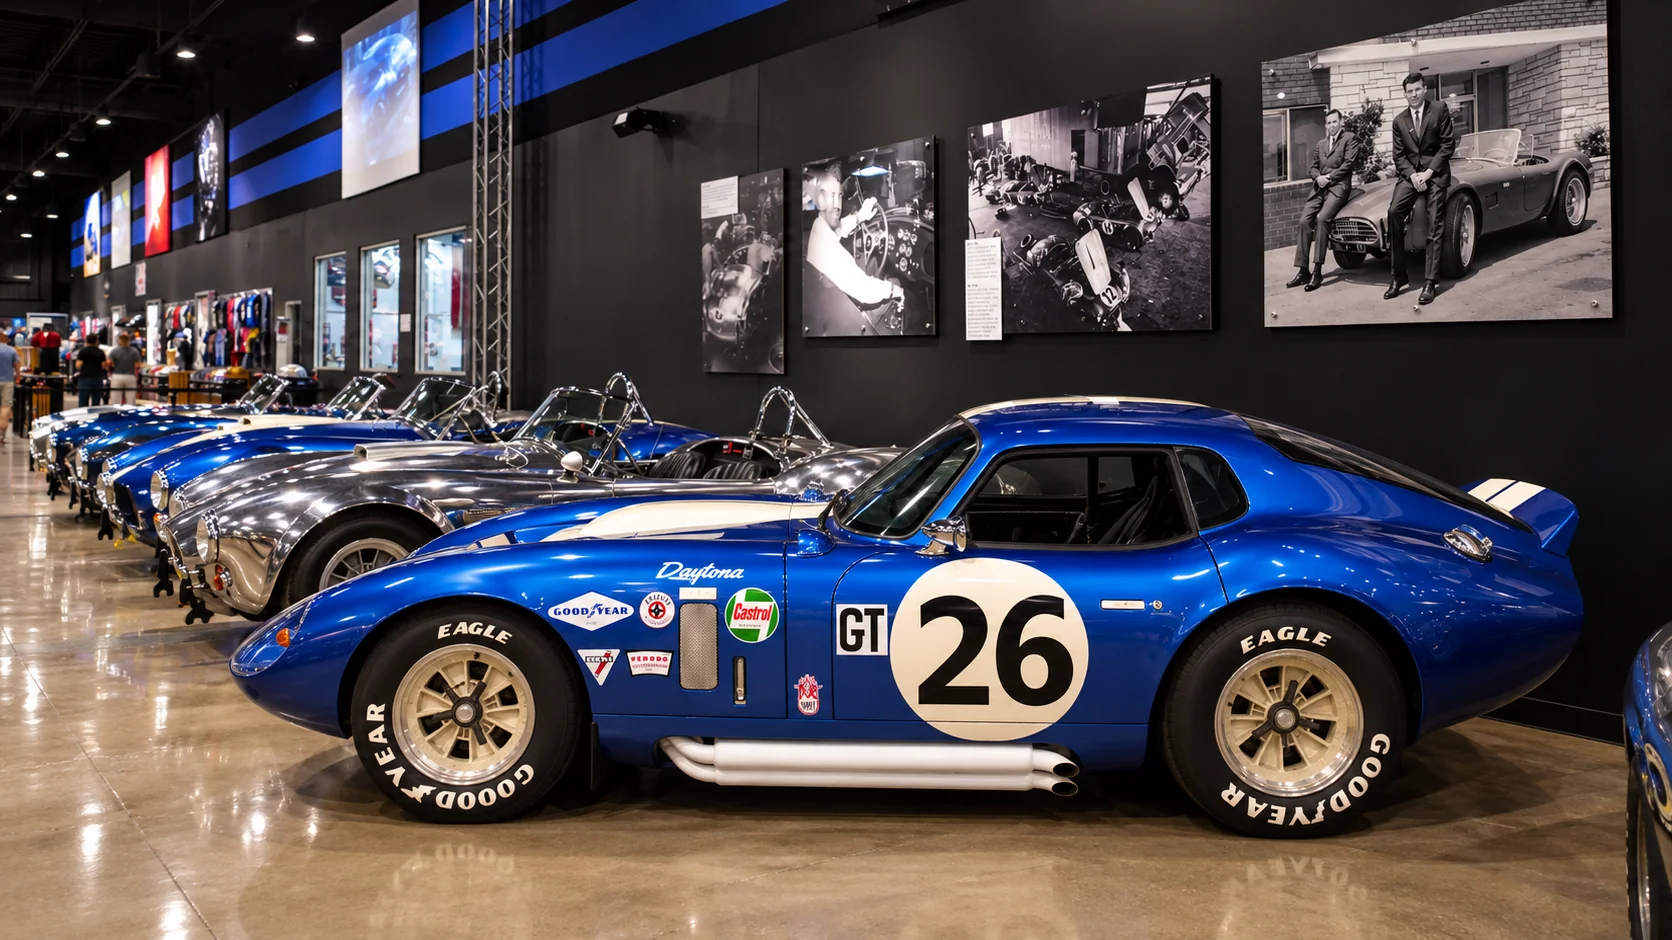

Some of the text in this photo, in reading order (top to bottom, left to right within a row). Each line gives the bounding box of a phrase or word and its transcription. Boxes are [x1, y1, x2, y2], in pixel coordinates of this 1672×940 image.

[1101, 287, 1117, 305] 12
[655, 561, 745, 586] Daytona
[553, 605, 628, 617] GOODYEAR
[733, 603, 773, 621] Castrol
[438, 621, 512, 645] EAGLE
[839, 608, 885, 652] GT
[1240, 626, 1332, 654] EAGLE
[918, 595, 1074, 707] 26
[1220, 733, 1390, 827] GOODYEAR
